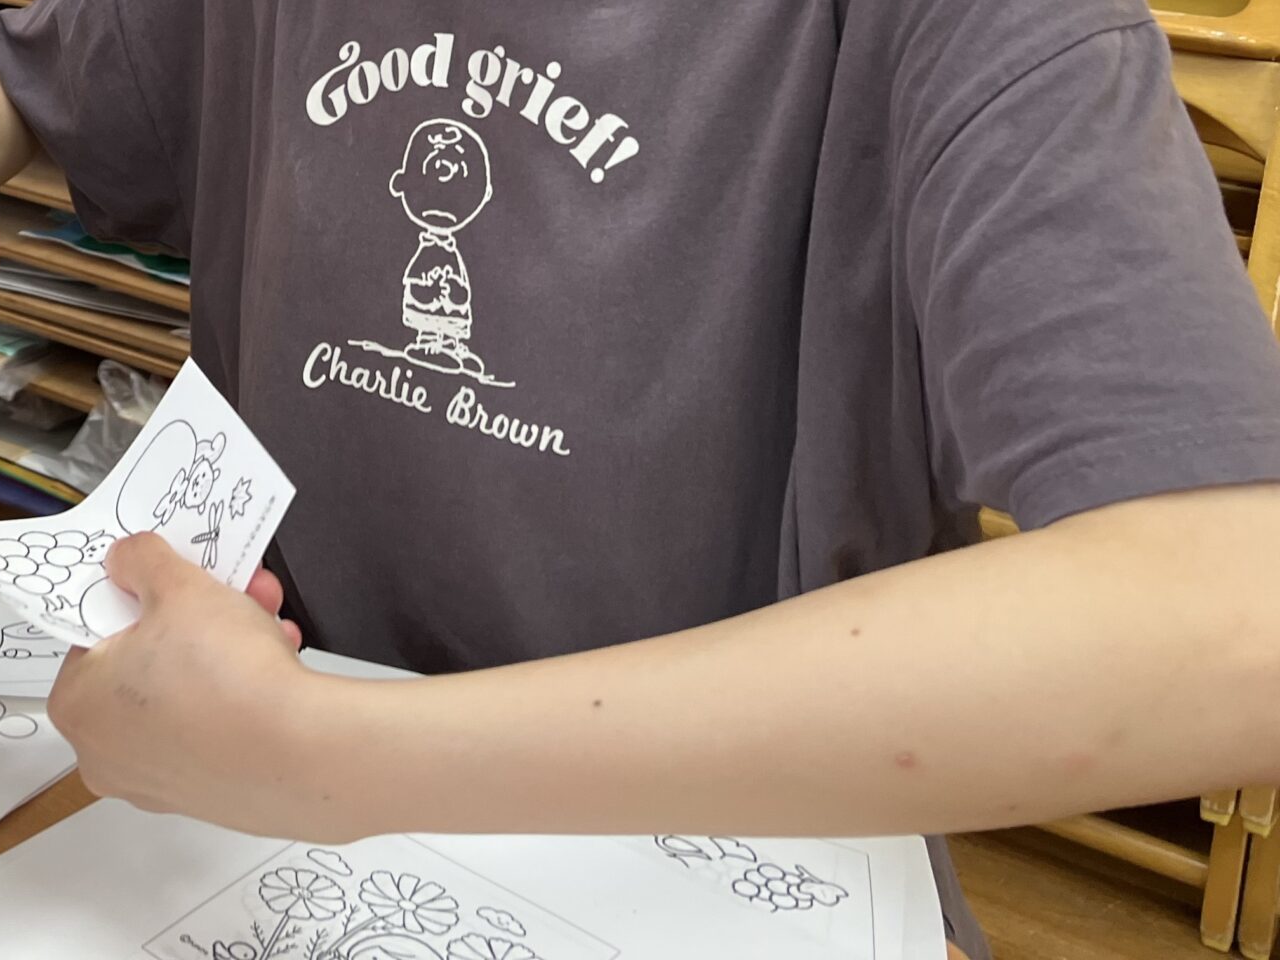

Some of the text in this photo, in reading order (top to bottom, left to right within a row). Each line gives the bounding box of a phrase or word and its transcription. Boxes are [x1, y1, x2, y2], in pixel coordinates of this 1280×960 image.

[305, 32, 640, 184] Good grief!
[302, 342, 571, 456] Charlie Brown
